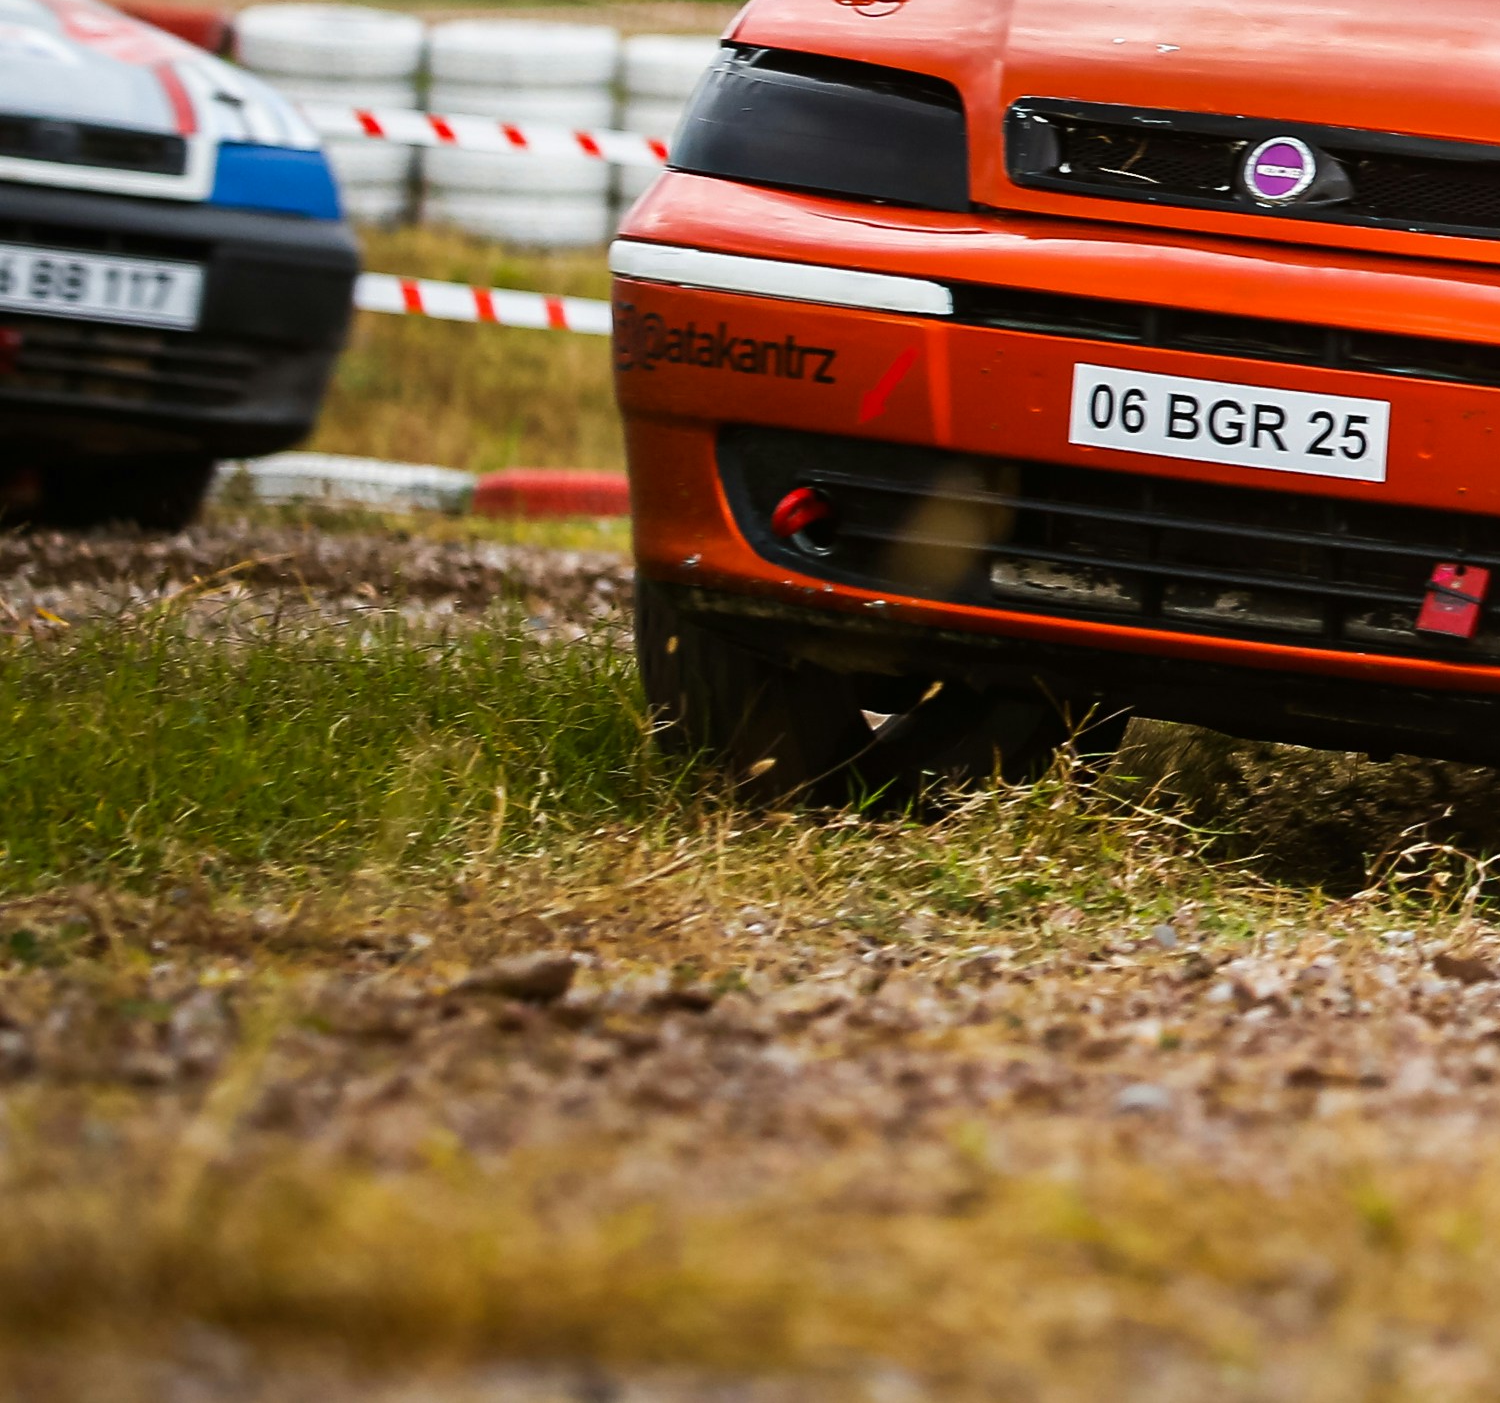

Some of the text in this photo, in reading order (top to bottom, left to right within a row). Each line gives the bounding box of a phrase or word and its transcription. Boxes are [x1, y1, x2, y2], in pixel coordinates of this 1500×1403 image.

[1090, 383, 1370, 460] 06 BGR 25
